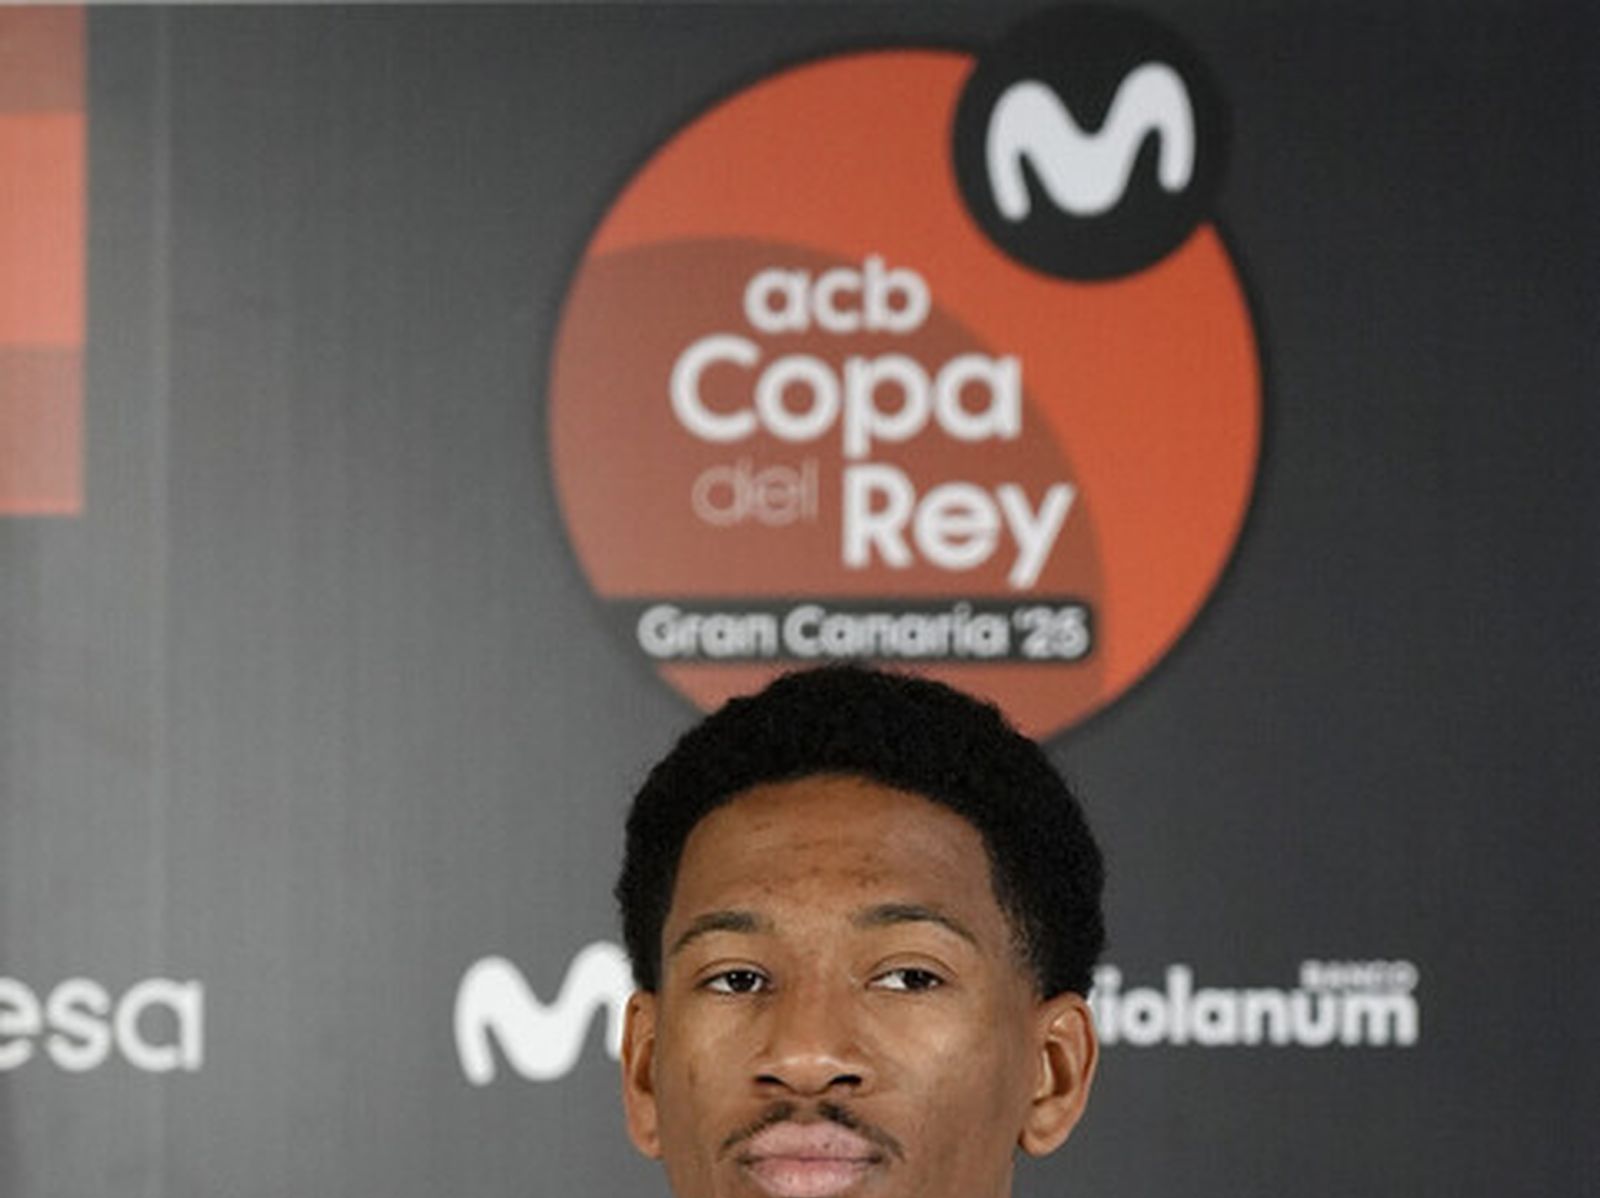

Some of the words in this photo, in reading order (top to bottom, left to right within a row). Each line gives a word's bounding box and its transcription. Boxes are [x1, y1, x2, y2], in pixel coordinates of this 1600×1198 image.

[743, 255, 931, 334] acb
[669, 334, 1022, 460] Copa
[692, 461, 818, 526] del
[842, 464, 1074, 590] Rey
[637, 604, 778, 658] Gran
[782, 602, 1009, 658] Canaria
[1012, 605, 1090, 659] '25
